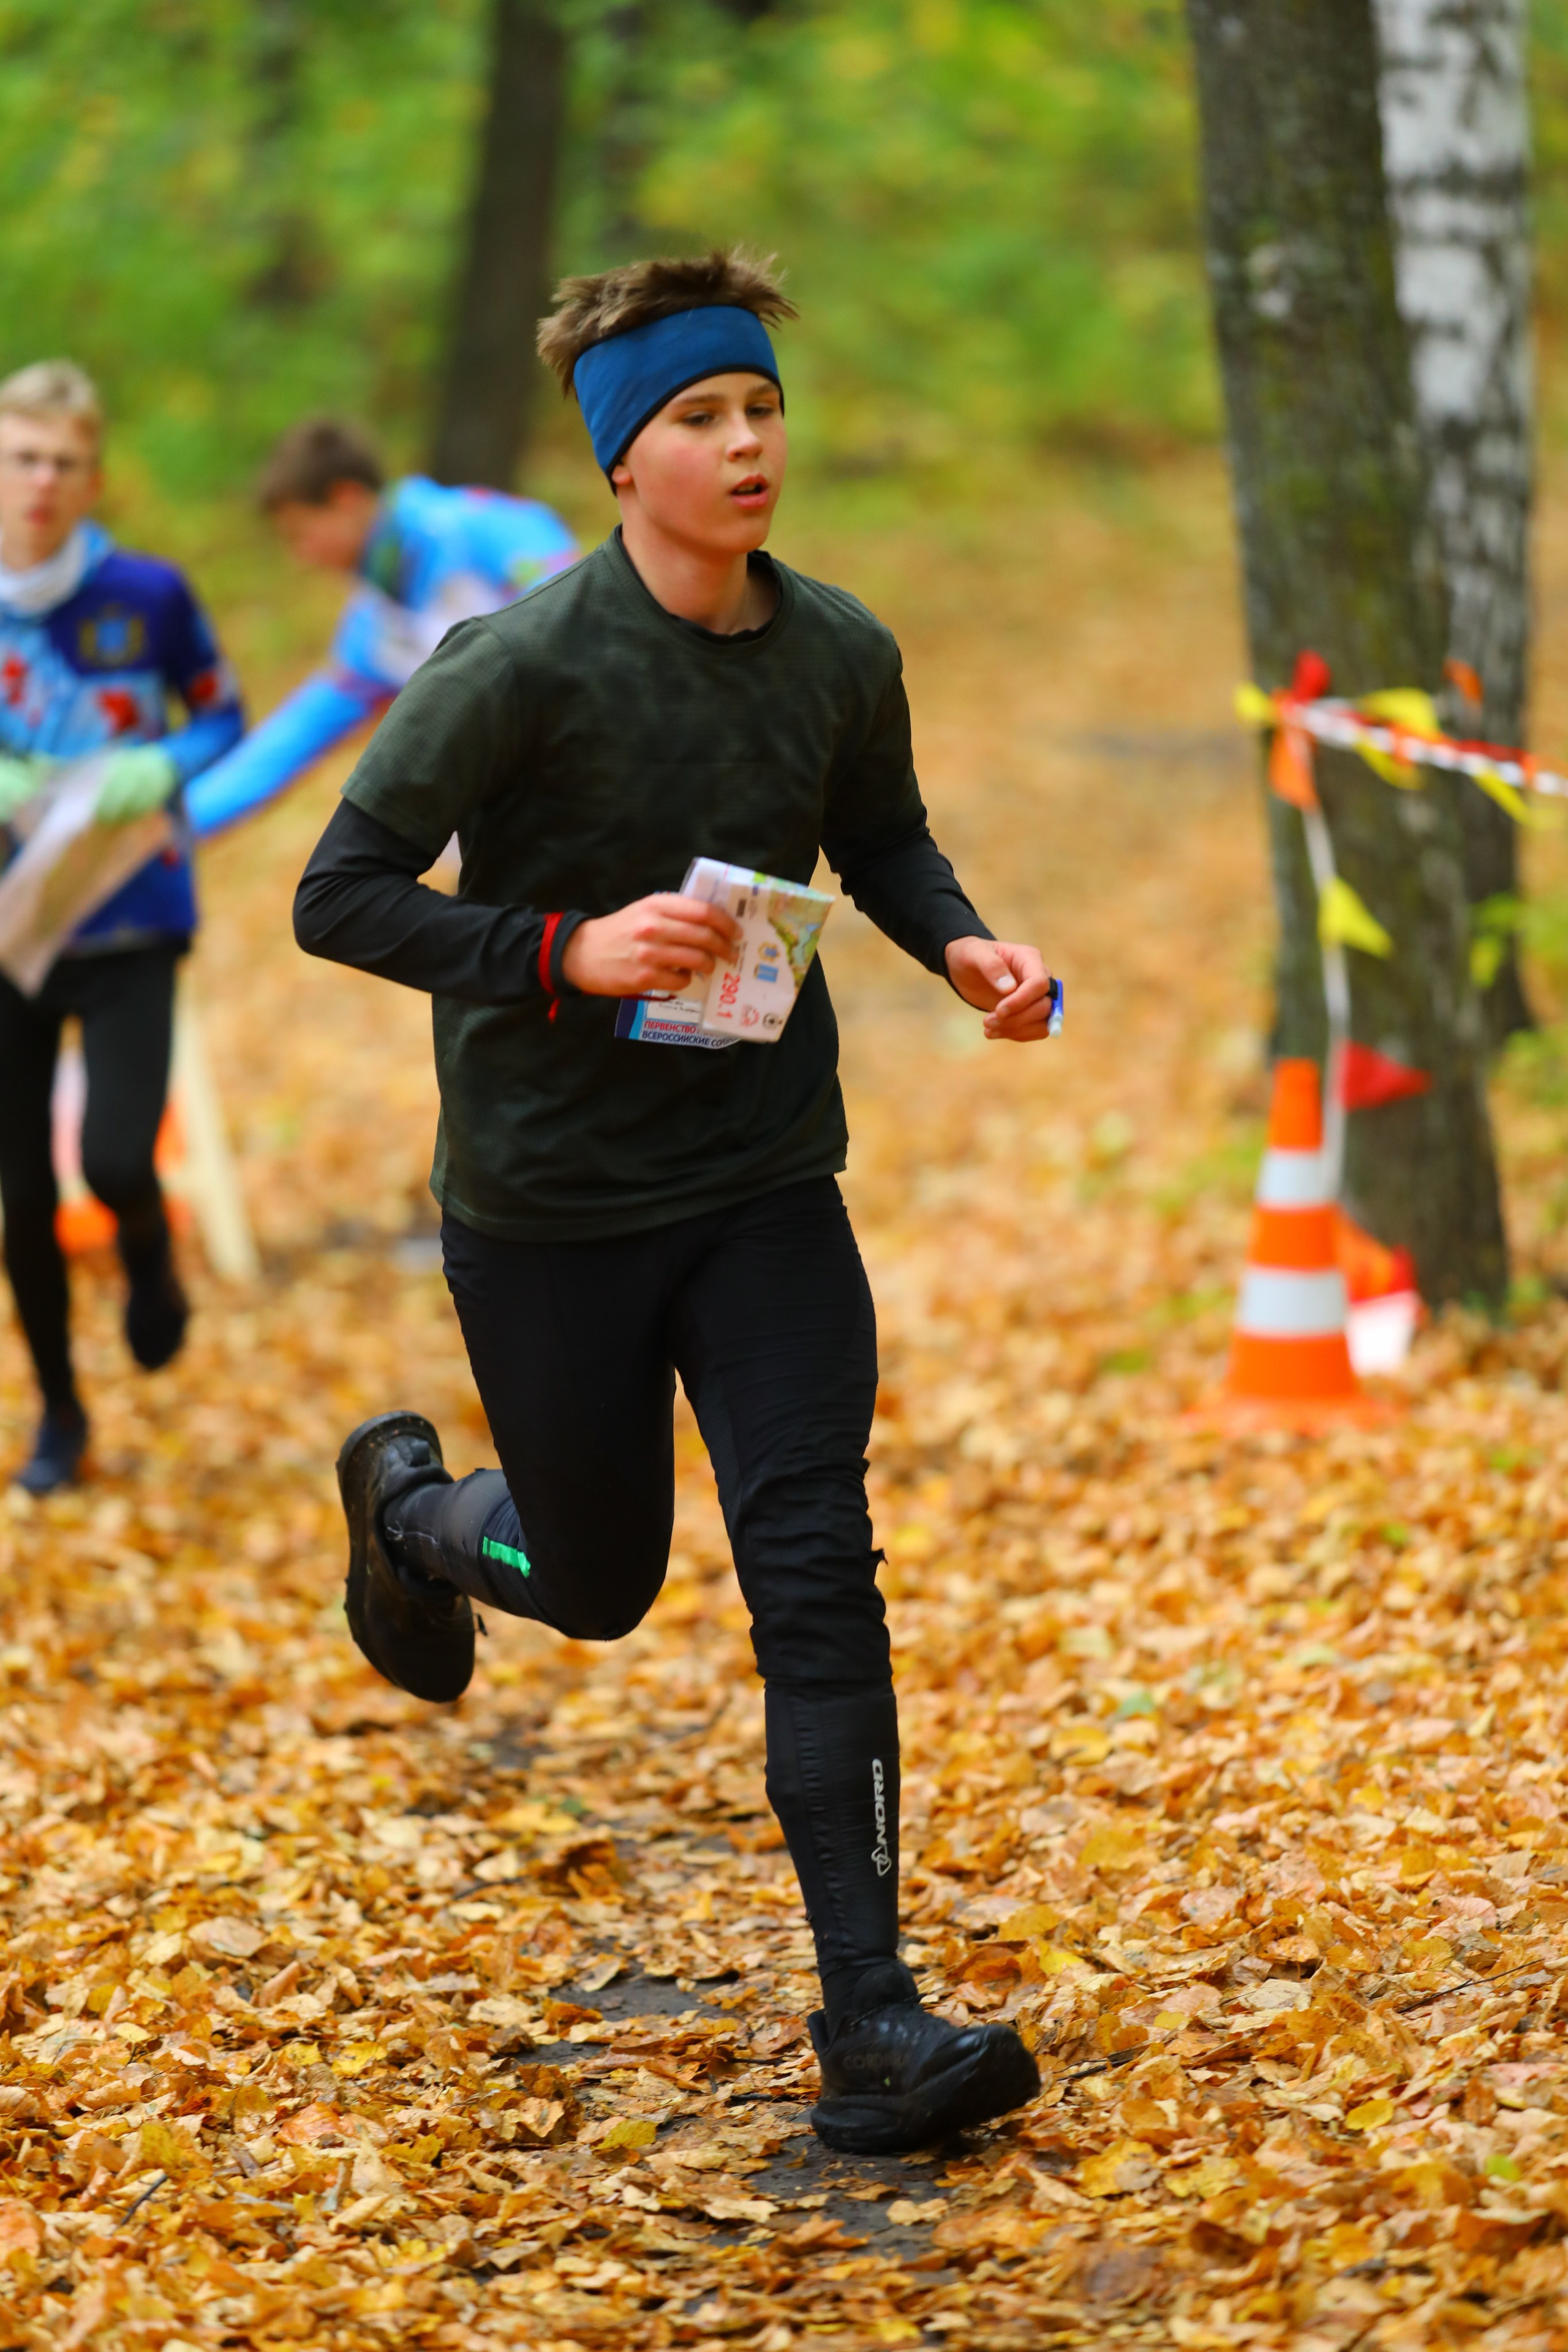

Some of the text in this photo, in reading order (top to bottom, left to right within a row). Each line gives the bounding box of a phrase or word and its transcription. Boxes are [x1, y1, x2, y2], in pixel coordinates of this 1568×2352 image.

[717, 972, 740, 1020] 290.1
[644, 1020, 696, 1034] ПЕРВЕНСТВО
[872, 1758, 887, 1845] NORD
